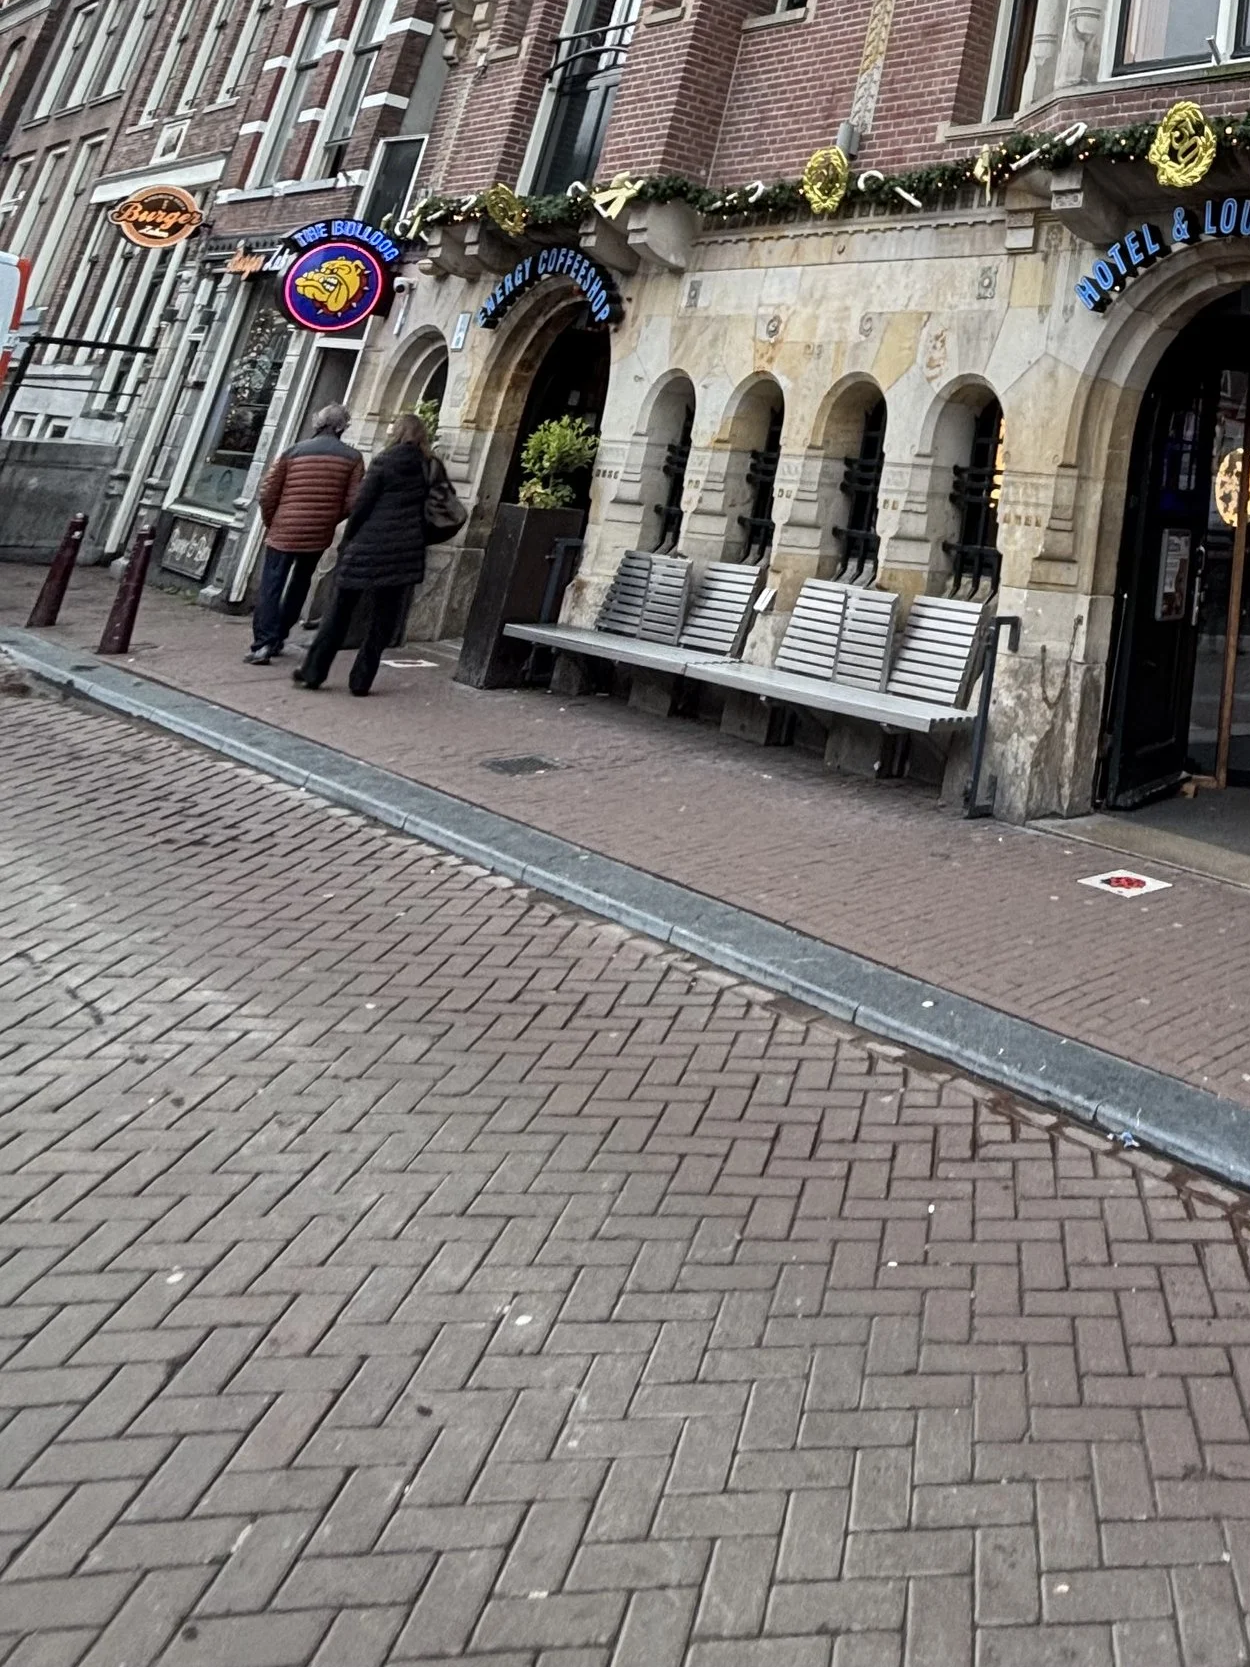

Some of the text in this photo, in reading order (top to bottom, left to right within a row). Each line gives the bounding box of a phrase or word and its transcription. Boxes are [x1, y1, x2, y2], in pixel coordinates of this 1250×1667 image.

[112, 201, 204, 230] Burger
[293, 222, 329, 248] THE
[331, 220, 400, 262] BULLDOG
[476, 247, 611, 327] ENERGY COFFEESHOP
[1074, 222, 1161, 311] HOTEL
[1171, 206, 1191, 242] &
